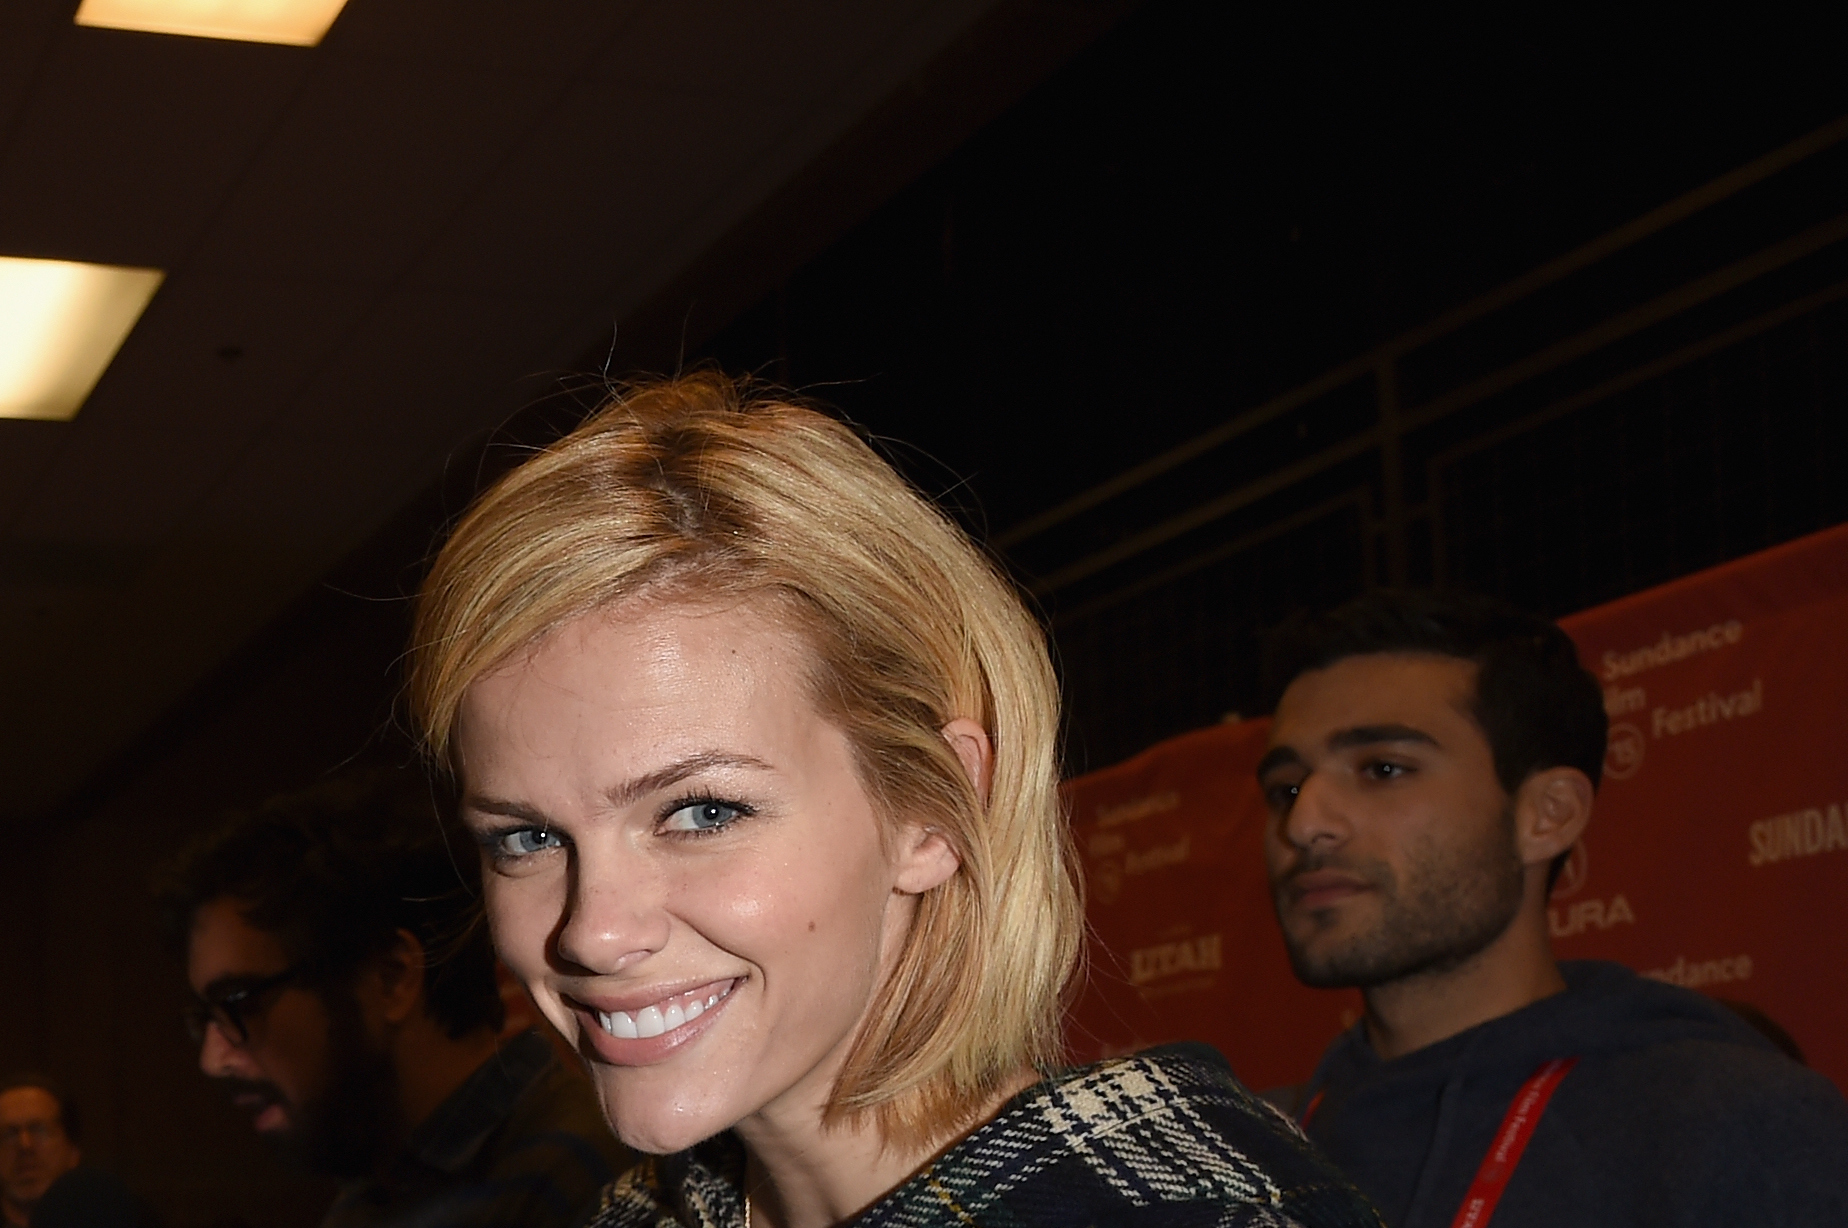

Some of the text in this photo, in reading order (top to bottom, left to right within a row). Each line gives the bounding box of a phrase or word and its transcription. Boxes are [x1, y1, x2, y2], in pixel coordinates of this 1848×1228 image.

[1602, 619, 1744, 682] Sundance
[1651, 678, 1763, 739] Festival
[1748, 802, 1848, 868] SUNDA
[1548, 894, 1636, 937] URA
